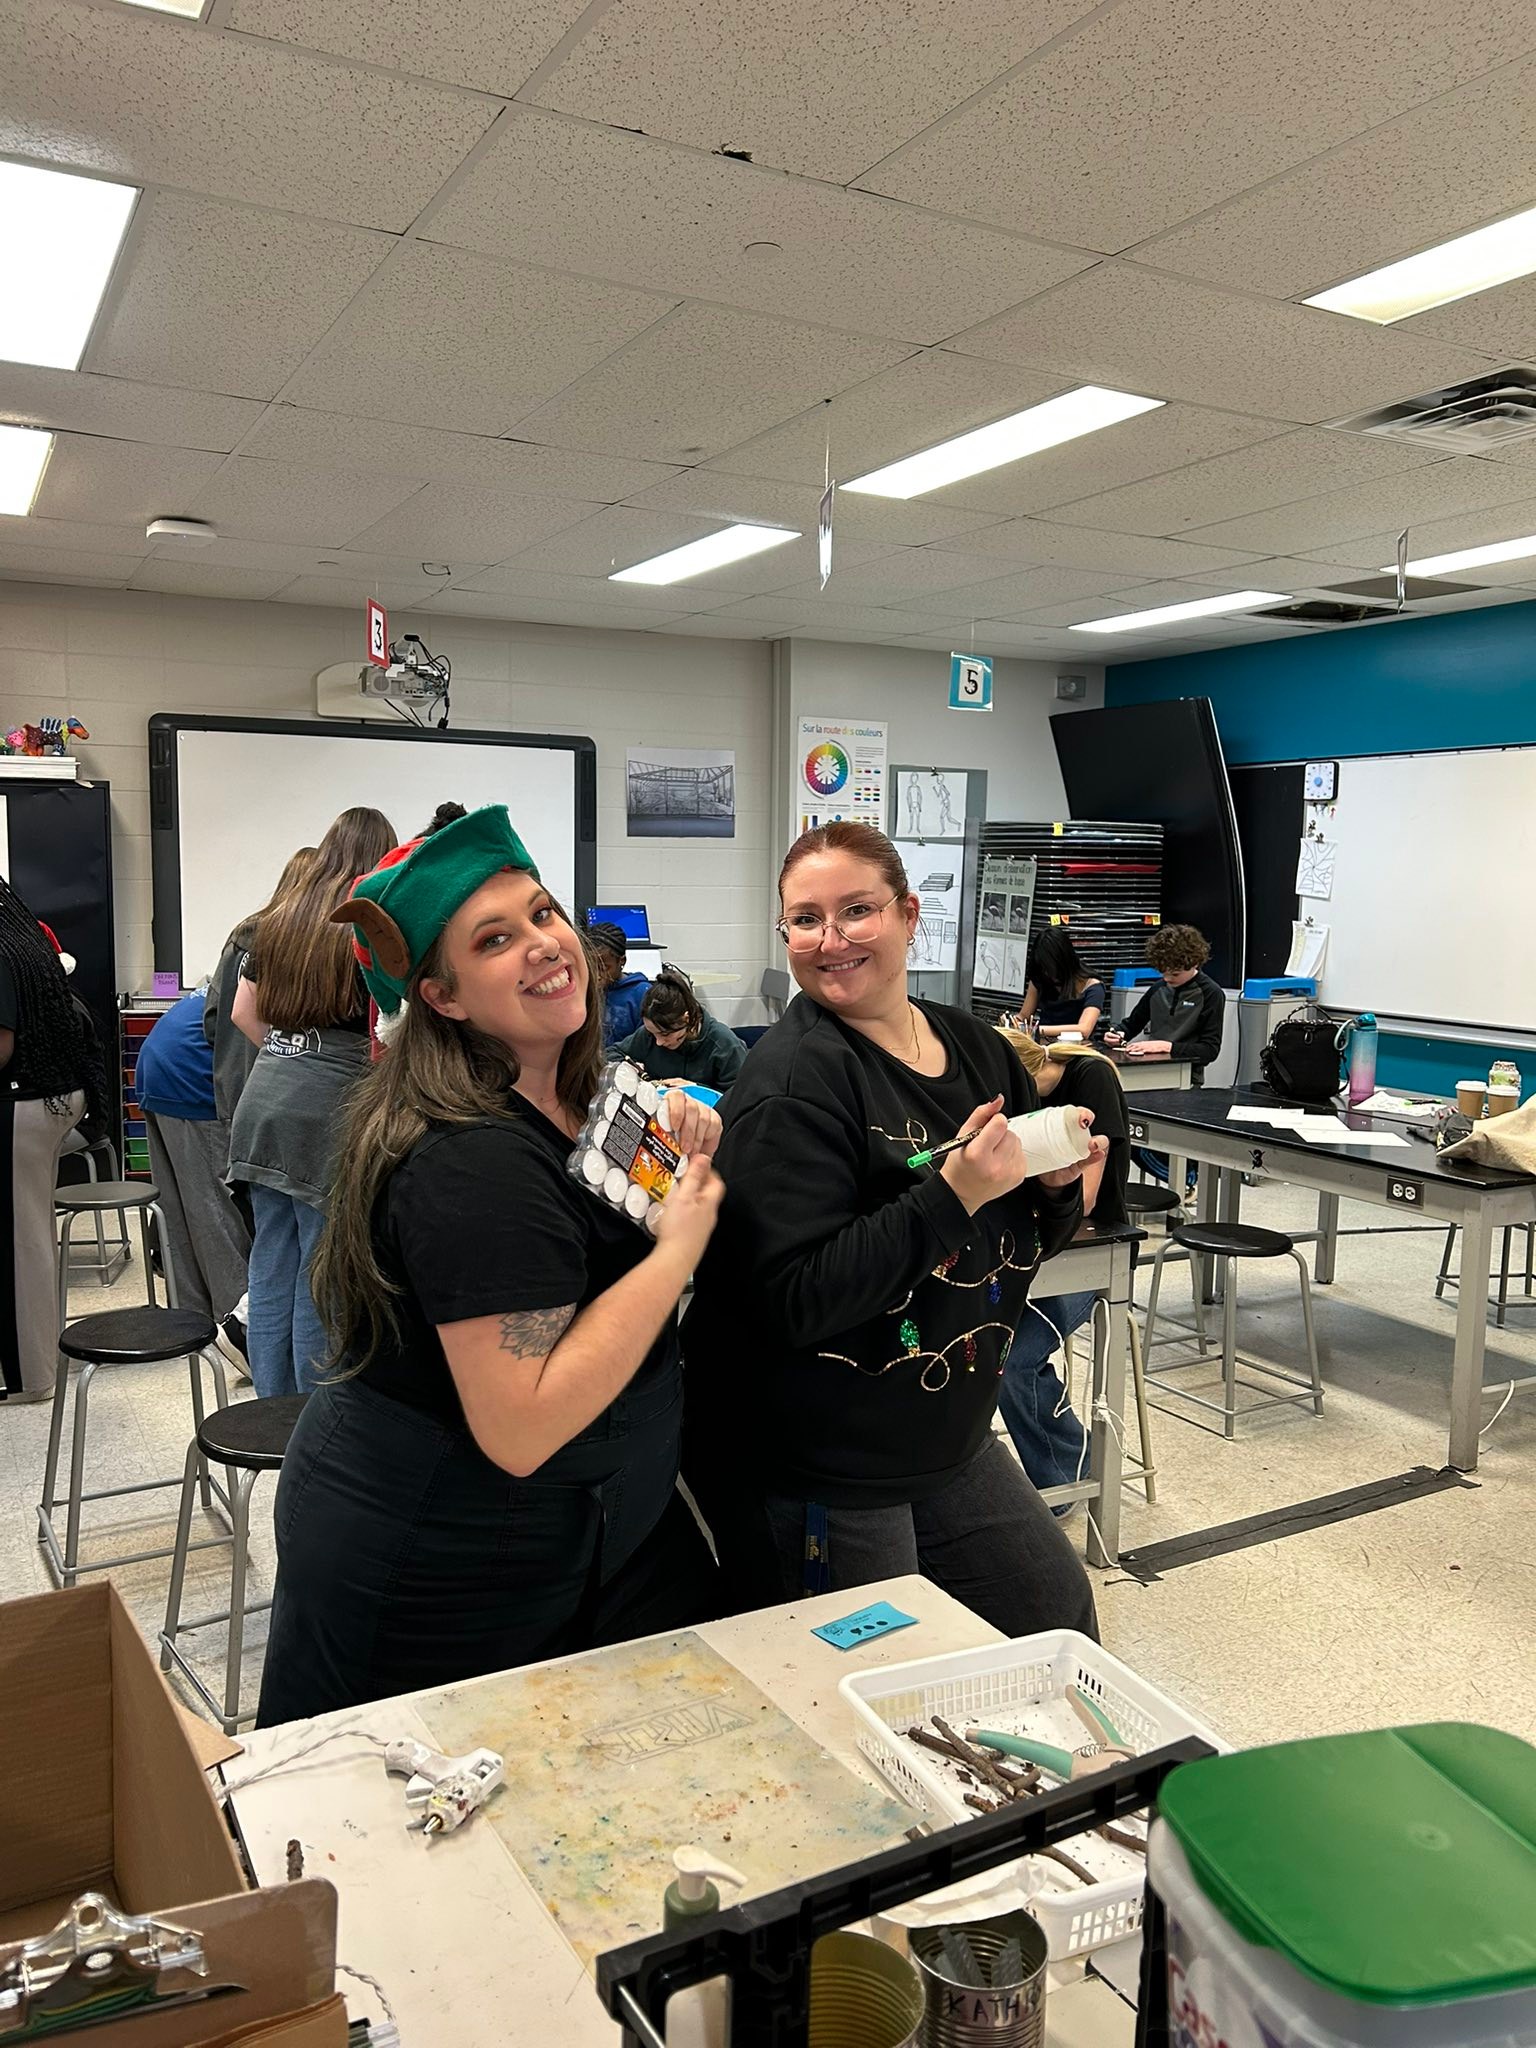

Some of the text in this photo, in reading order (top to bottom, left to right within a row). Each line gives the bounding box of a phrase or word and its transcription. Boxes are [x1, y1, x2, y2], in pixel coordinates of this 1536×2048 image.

[374, 618, 382, 652] 3
[964, 668, 979, 695] 5
[802, 723, 815, 733] Sur
[816, 724, 823, 733] la
[823, 726, 841, 735] route
[855, 728, 884, 738] couleurs
